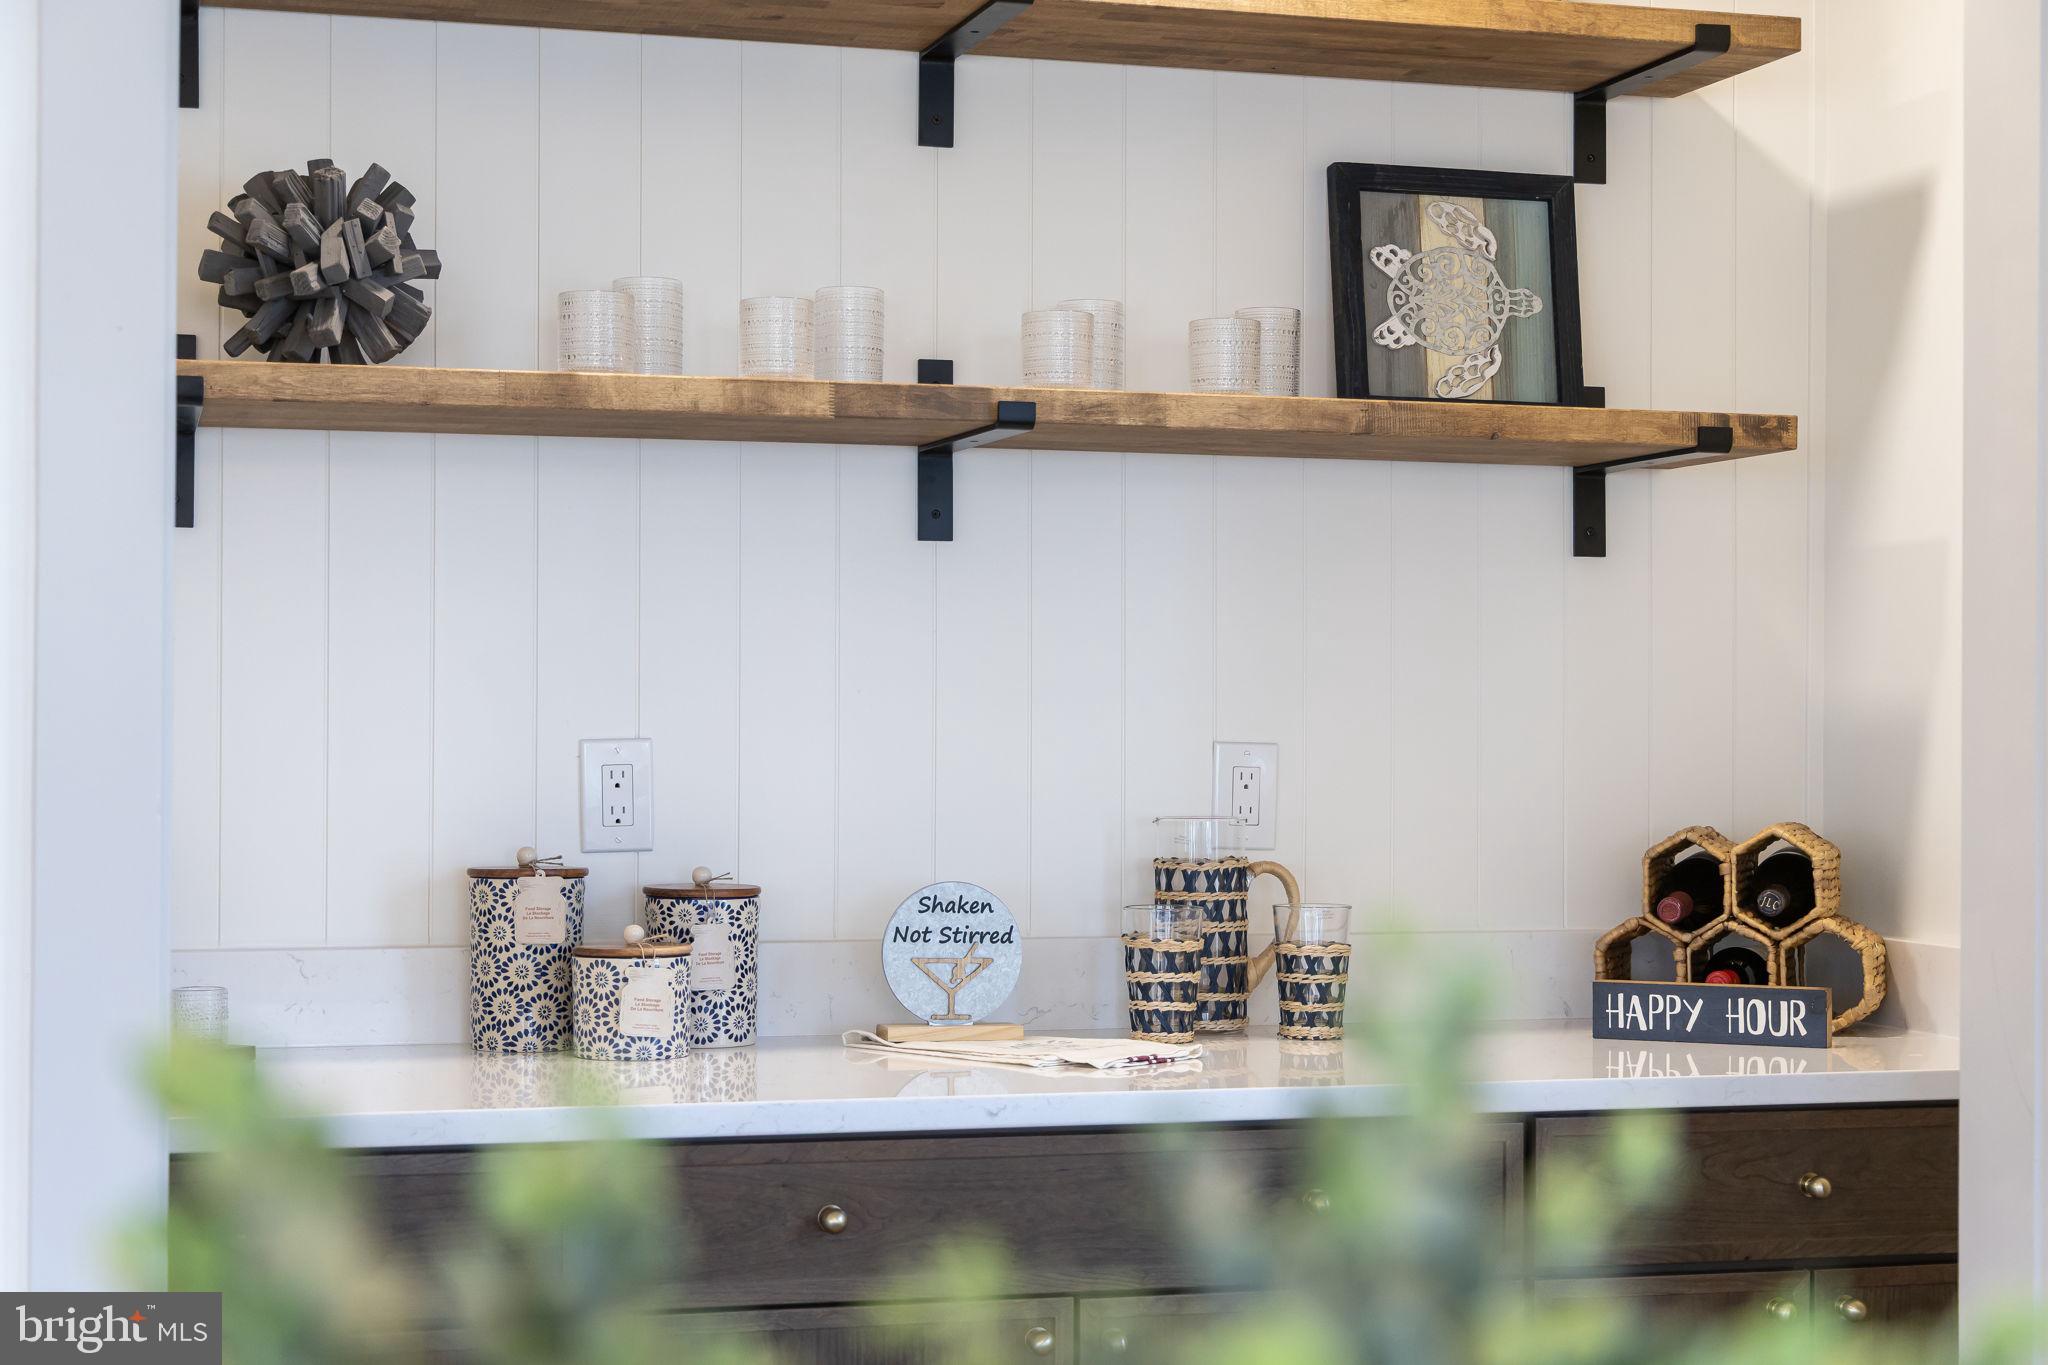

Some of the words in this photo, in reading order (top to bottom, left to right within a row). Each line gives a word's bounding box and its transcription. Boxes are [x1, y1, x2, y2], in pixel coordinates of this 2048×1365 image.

[917, 894, 994, 914] Shaken
[893, 926, 932, 943] Not
[938, 925, 1014, 944] Stirred
[1606, 993, 1703, 1032] HAPPY
[1725, 998, 1807, 1037] HOUR
